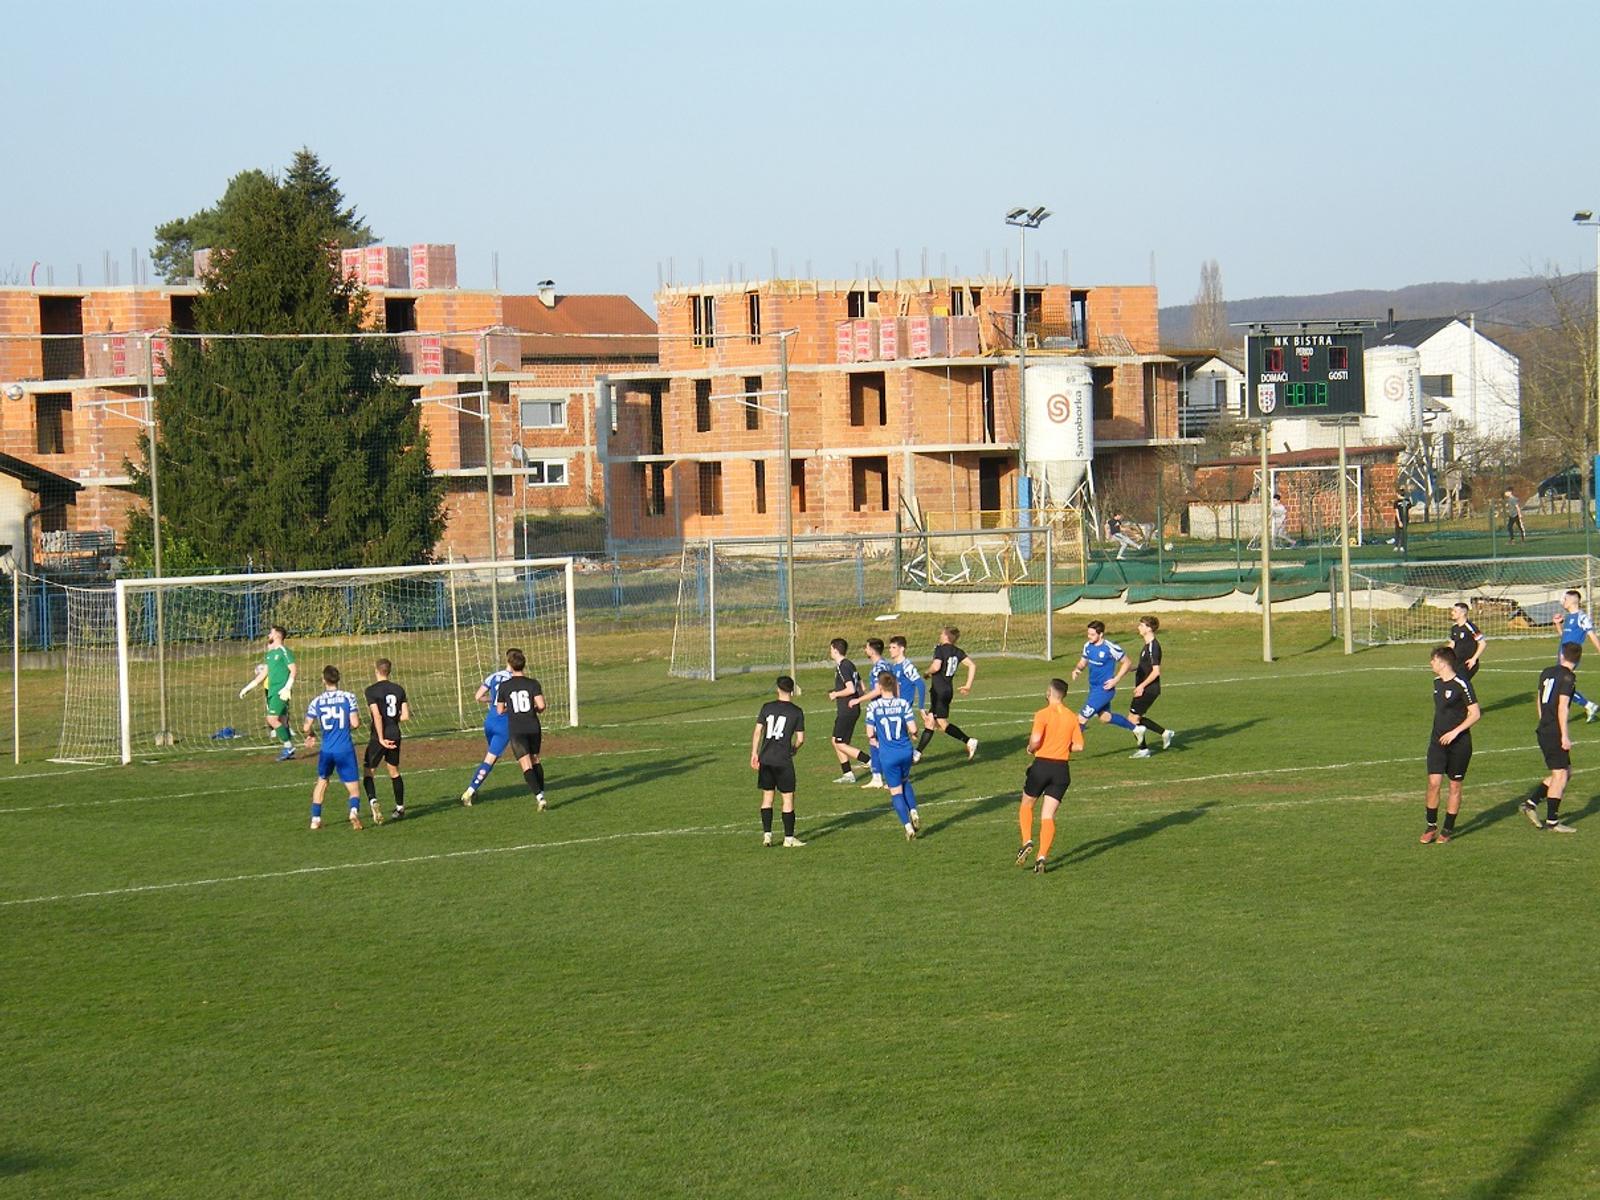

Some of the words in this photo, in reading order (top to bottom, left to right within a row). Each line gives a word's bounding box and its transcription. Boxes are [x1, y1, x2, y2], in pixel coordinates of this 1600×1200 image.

[1274, 336, 1289, 346] NK
[1294, 335, 1333, 346] BISTRA
[1328, 371, 1349, 381] GOSTI
[385, 694, 397, 717] 3
[509, 690, 531, 713] 16
[319, 706, 345, 730] 24
[766, 714, 787, 739] 14
[880, 716, 902, 741] 17
